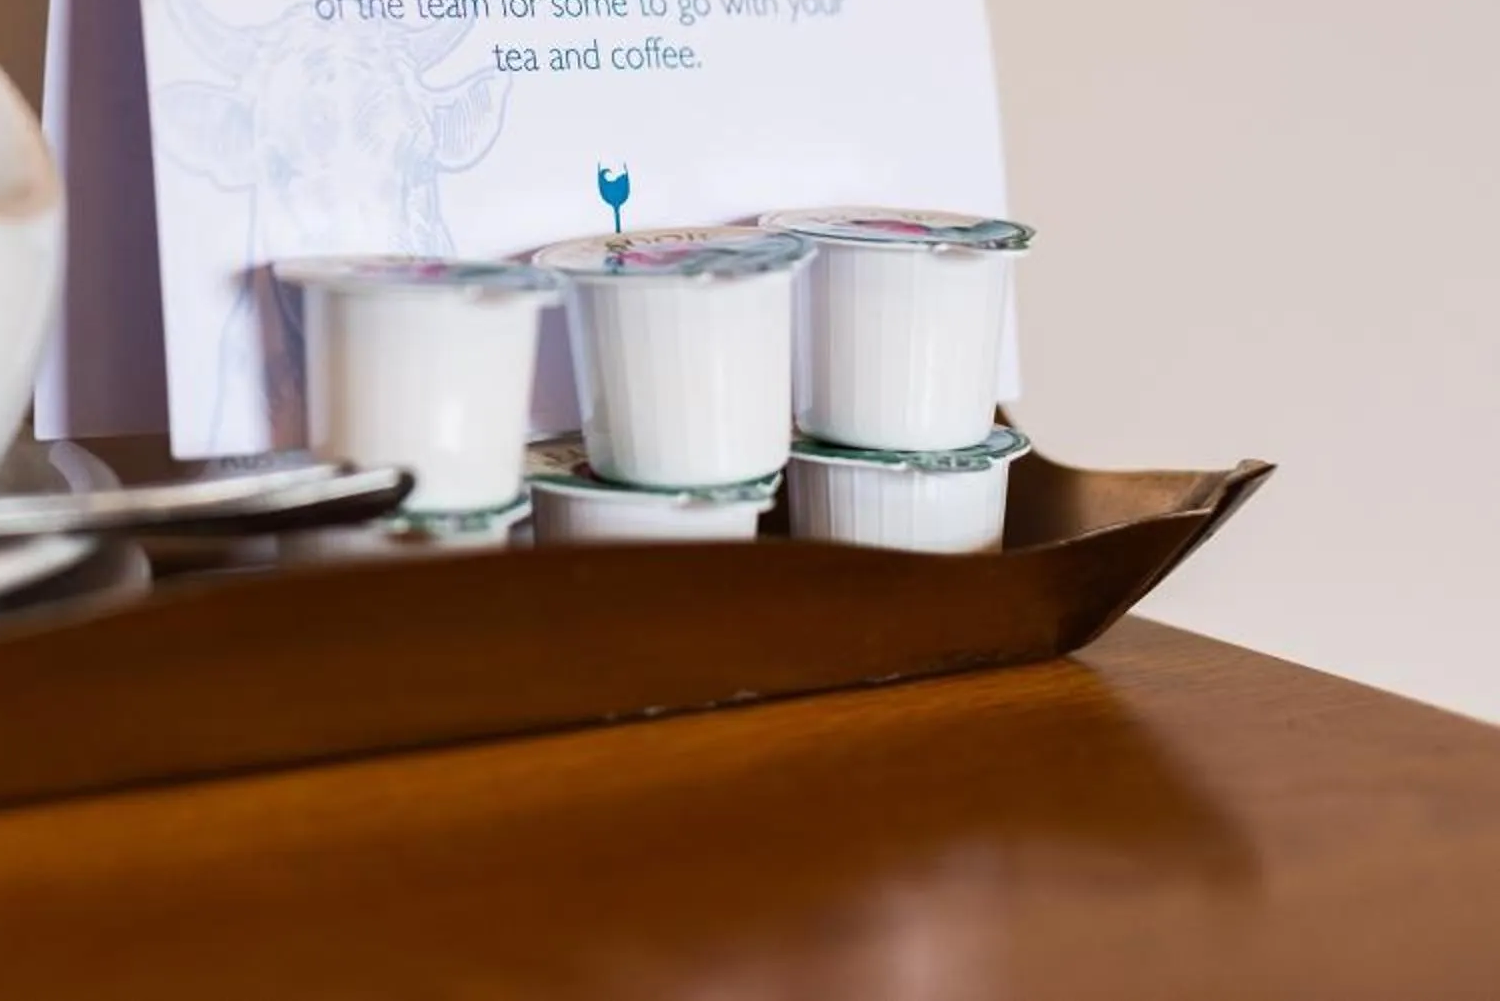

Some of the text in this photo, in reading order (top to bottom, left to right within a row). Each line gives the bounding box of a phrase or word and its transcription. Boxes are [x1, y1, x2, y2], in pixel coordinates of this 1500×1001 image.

[492, 36, 703, 71] tea and coffee.
